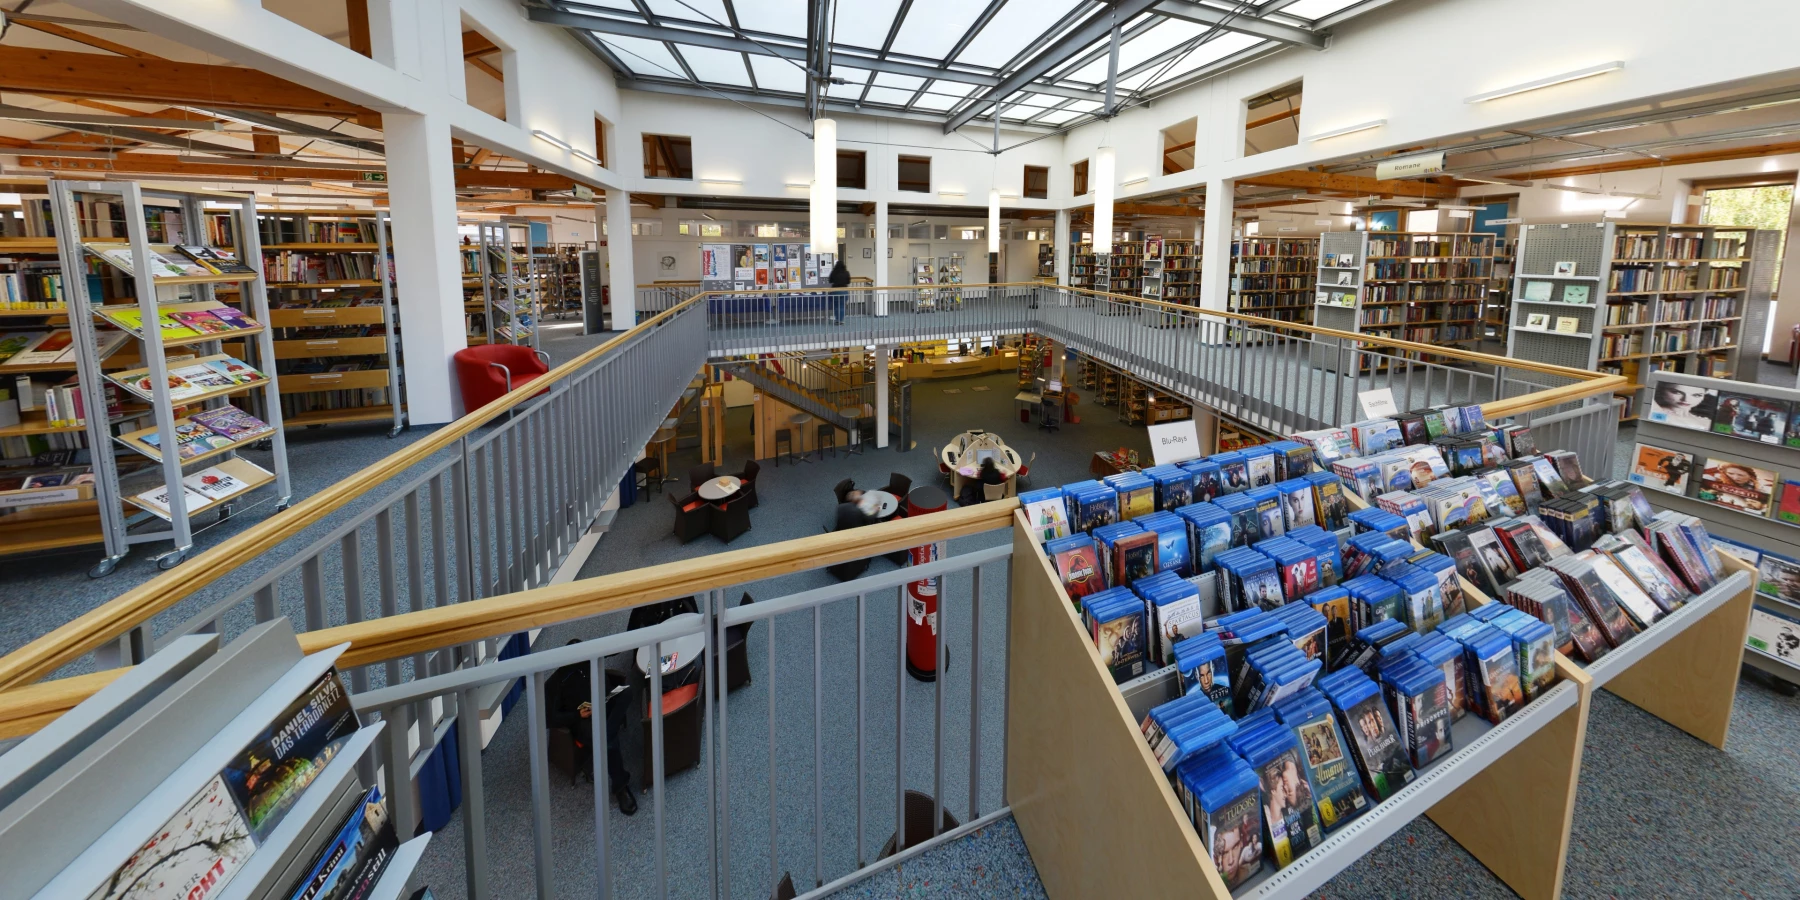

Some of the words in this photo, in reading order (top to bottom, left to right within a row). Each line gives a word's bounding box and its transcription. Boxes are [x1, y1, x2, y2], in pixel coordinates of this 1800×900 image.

[1394, 163, 1421, 171] Romane
[1368, 399, 1389, 408] Sachfilme
[1161, 436, 1187, 446] Blu-Rays
[1210, 690, 1229, 701] EARTH
[270, 708, 310, 749] DANIEL
[309, 681, 337, 710] SILVA
[275, 735, 294, 760] DAS
[293, 688, 340, 740] TERRORNETZ
[1417, 708, 1447, 730] PRISONERS
[1226, 795, 1256, 821] TUDORS
[318, 847, 344, 883] Krimi
[352, 847, 387, 900] enstill
